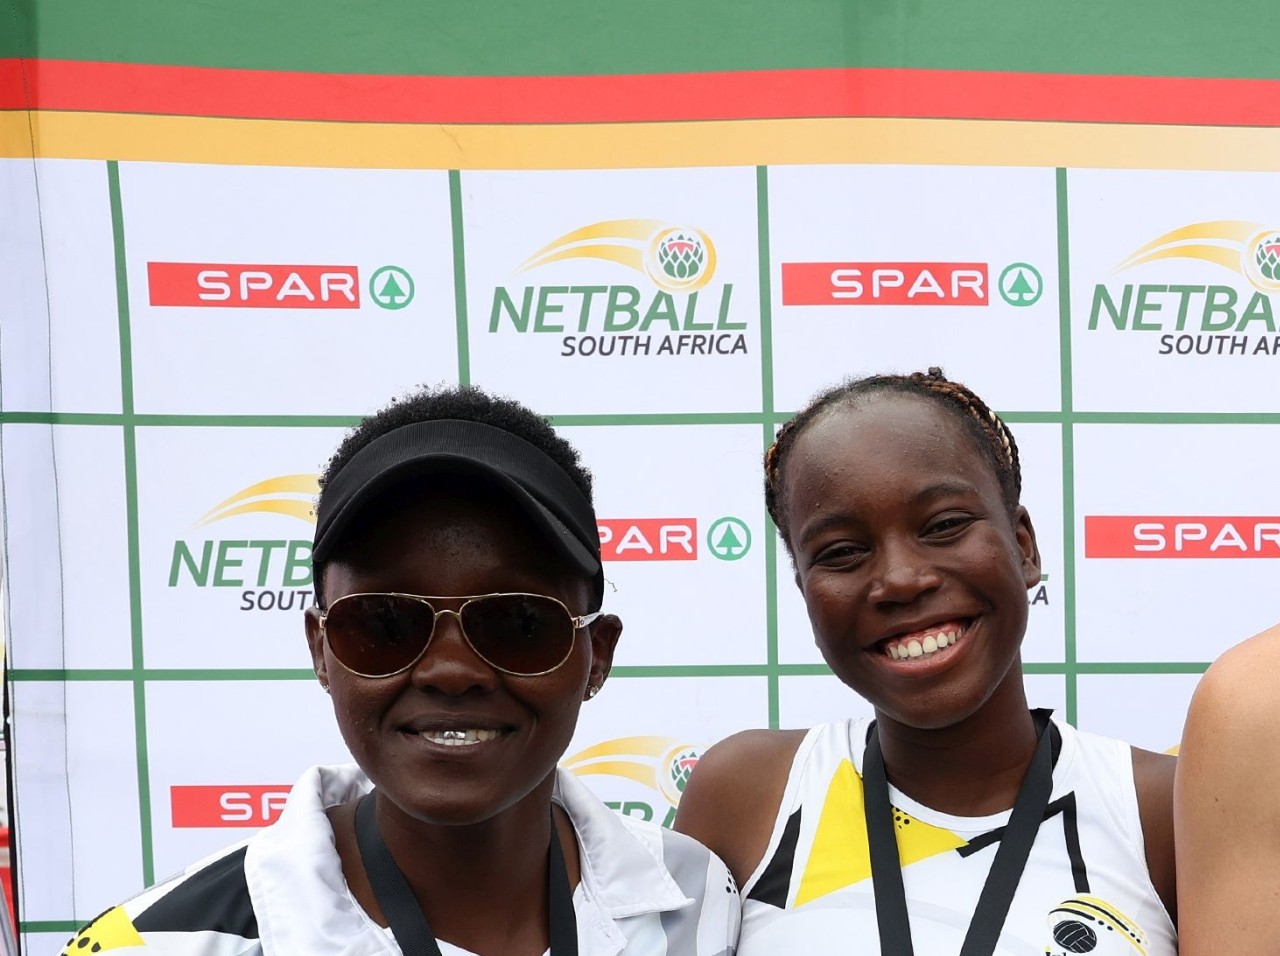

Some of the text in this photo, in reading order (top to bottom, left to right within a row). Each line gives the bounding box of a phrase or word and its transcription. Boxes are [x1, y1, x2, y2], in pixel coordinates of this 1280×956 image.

[197, 270, 356, 302] SPAR
[830, 268, 985, 300] SPAR
[488, 284, 748, 333] NETBALL
[561, 334, 748, 356] SOUTH AFRICA
[1159, 334, 1248, 355] SOUTH
[598, 525, 693, 555] PAR
[168, 540, 314, 587] NETB
[240, 590, 318, 611] SOUT
[220, 792, 290, 821] SP
